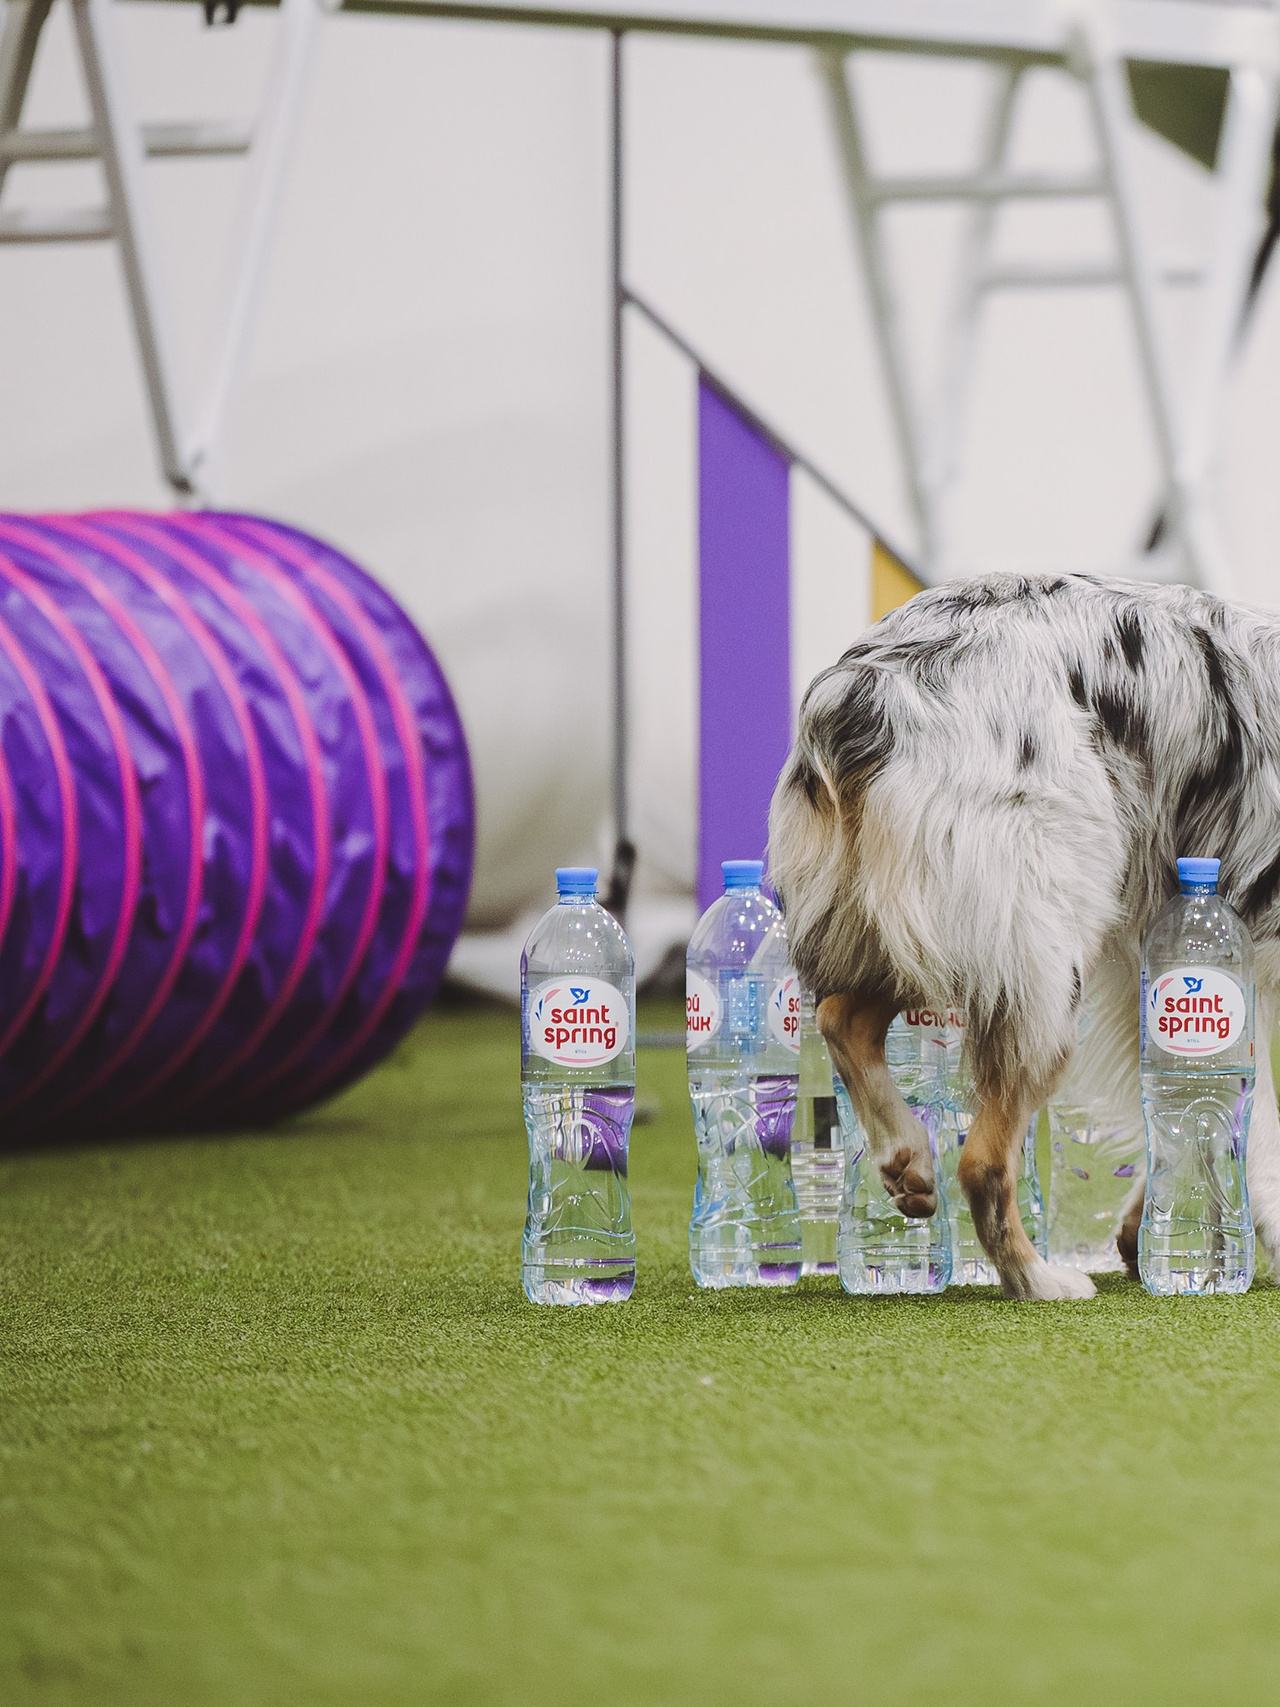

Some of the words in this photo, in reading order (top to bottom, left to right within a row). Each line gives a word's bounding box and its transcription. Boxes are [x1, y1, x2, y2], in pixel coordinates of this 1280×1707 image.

[1164, 994, 1223, 1013] saint
[551, 1005, 610, 1024] saint
[1158, 1016, 1230, 1039] spring
[544, 1027, 616, 1049] spring
